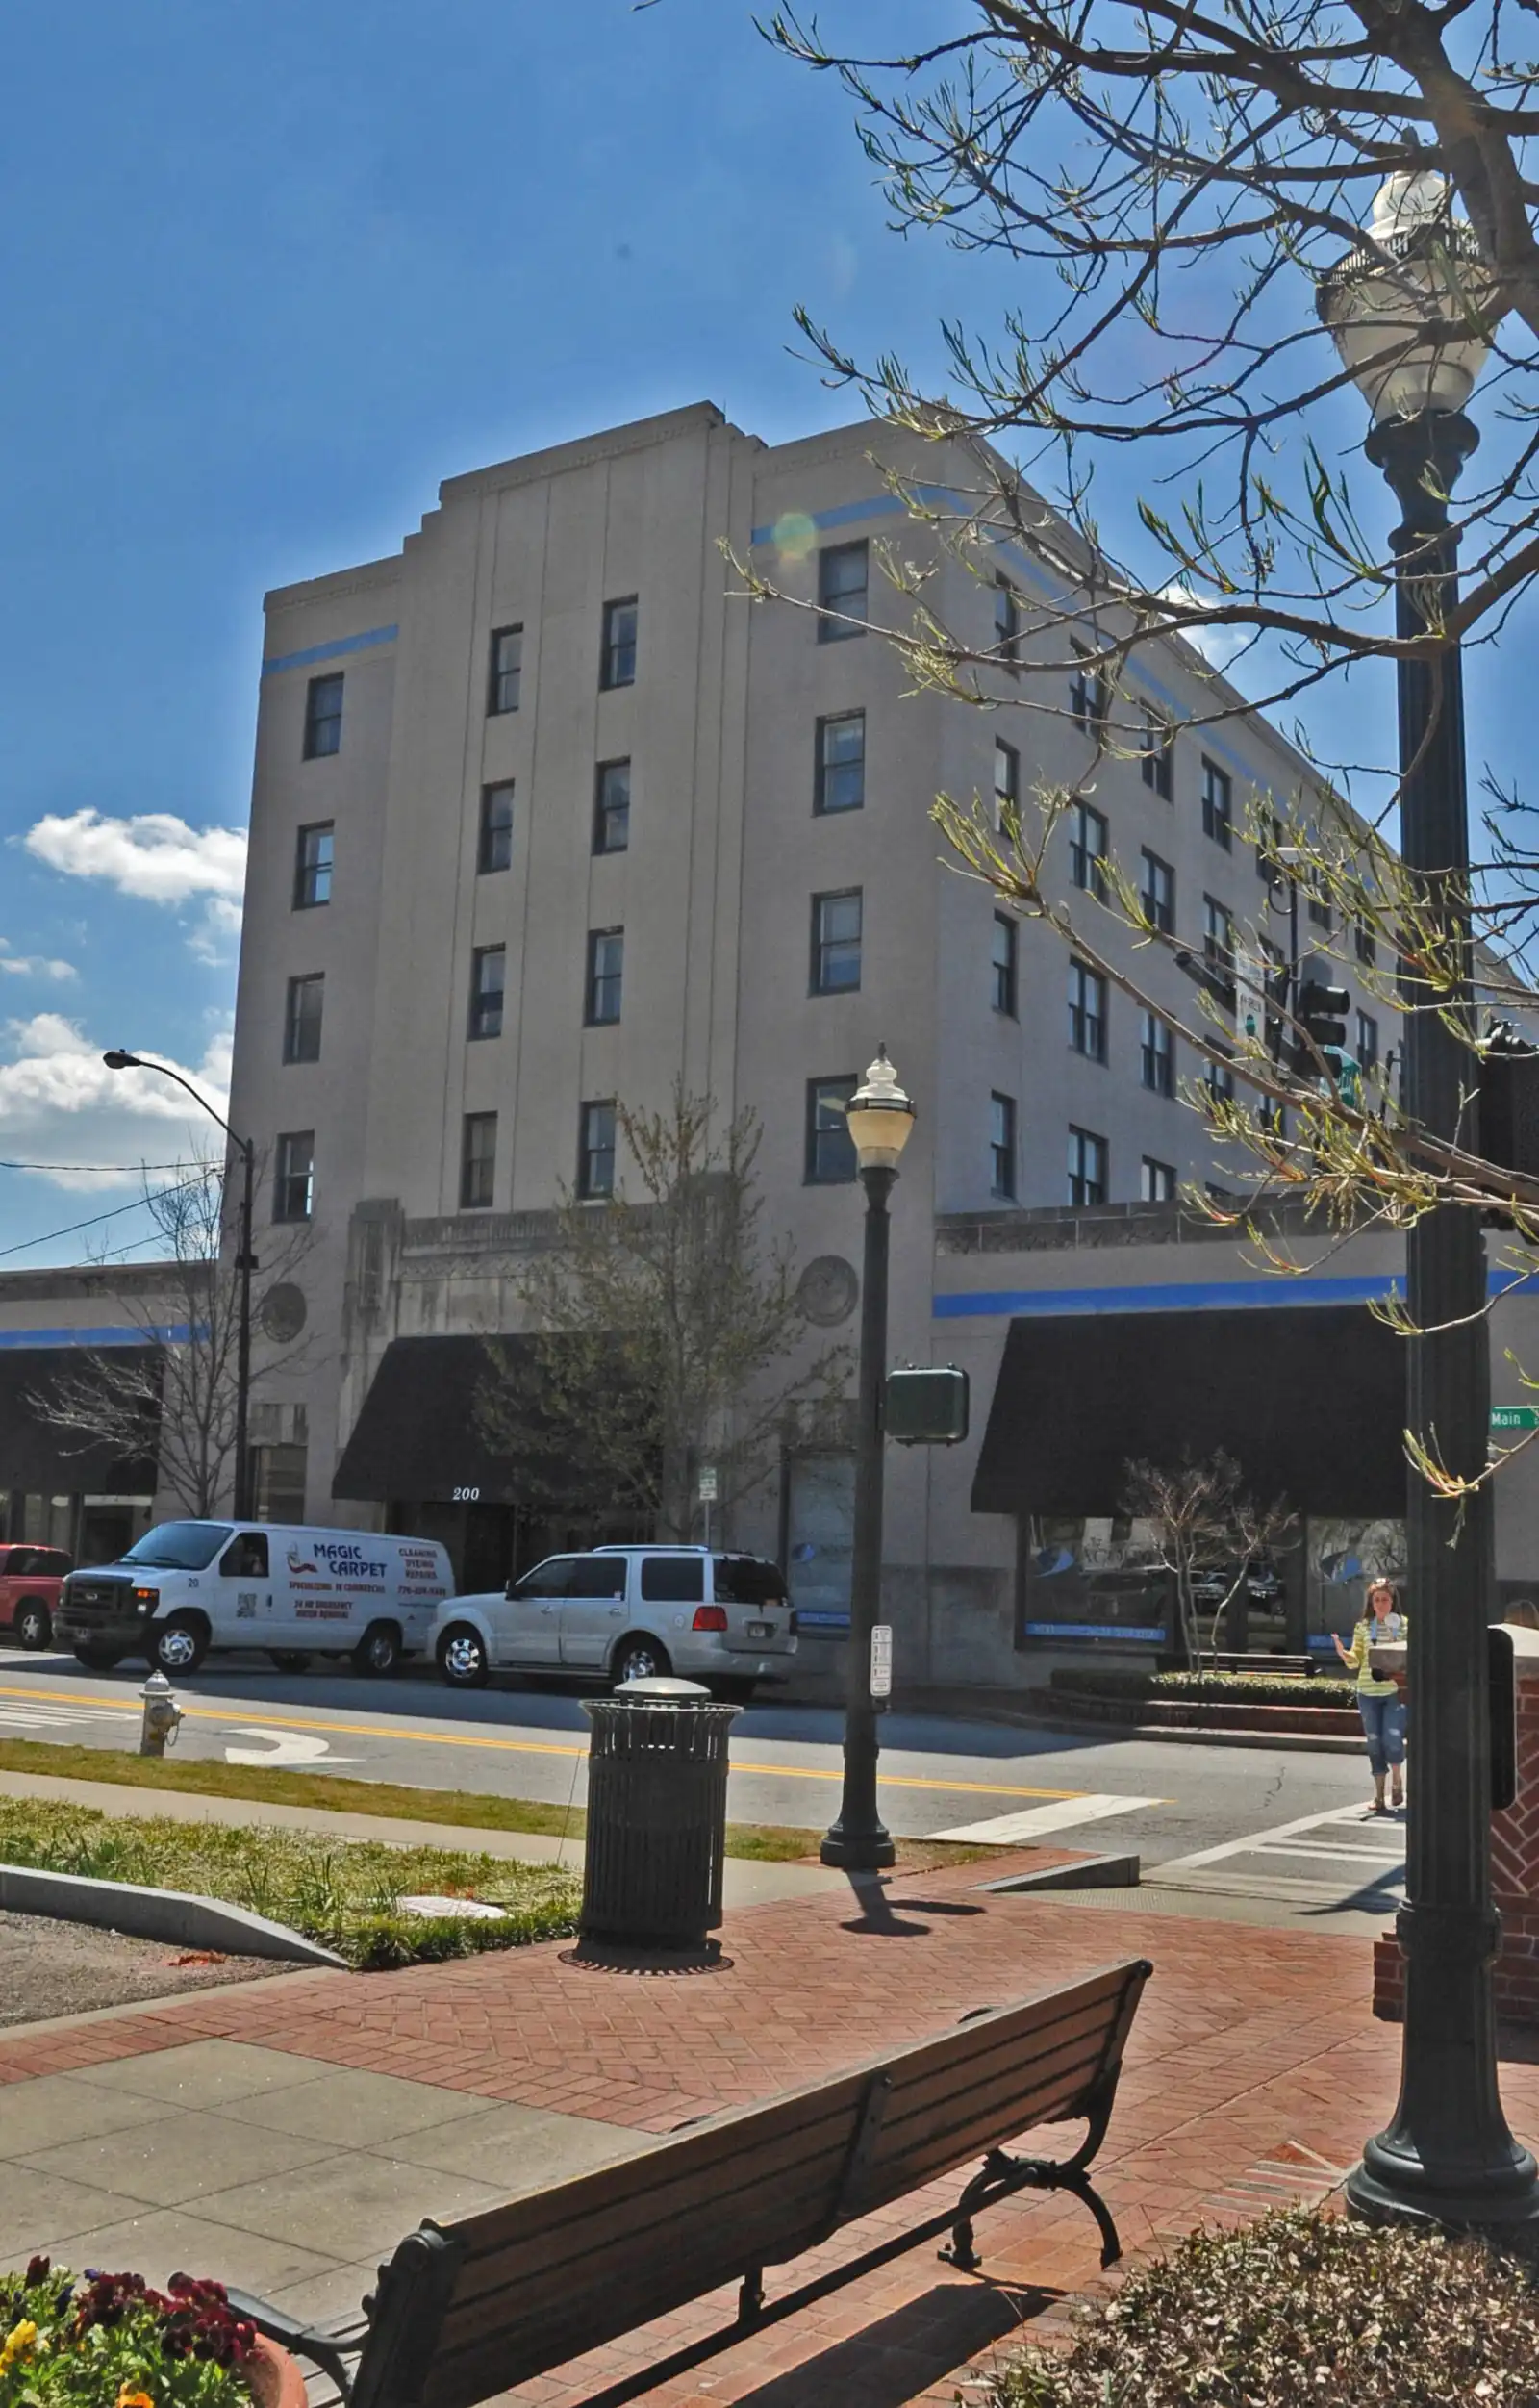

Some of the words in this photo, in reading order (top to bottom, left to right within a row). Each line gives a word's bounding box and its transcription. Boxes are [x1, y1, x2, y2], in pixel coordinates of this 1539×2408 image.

[1492, 1412, 1521, 1425] Main
[452, 1486, 480, 1501] 200
[314, 1543, 362, 1559] MAGIC
[398, 1547, 438, 1558] CLEANING
[329, 1560, 388, 1578] CARPET
[188, 1578, 199, 1588] 20
